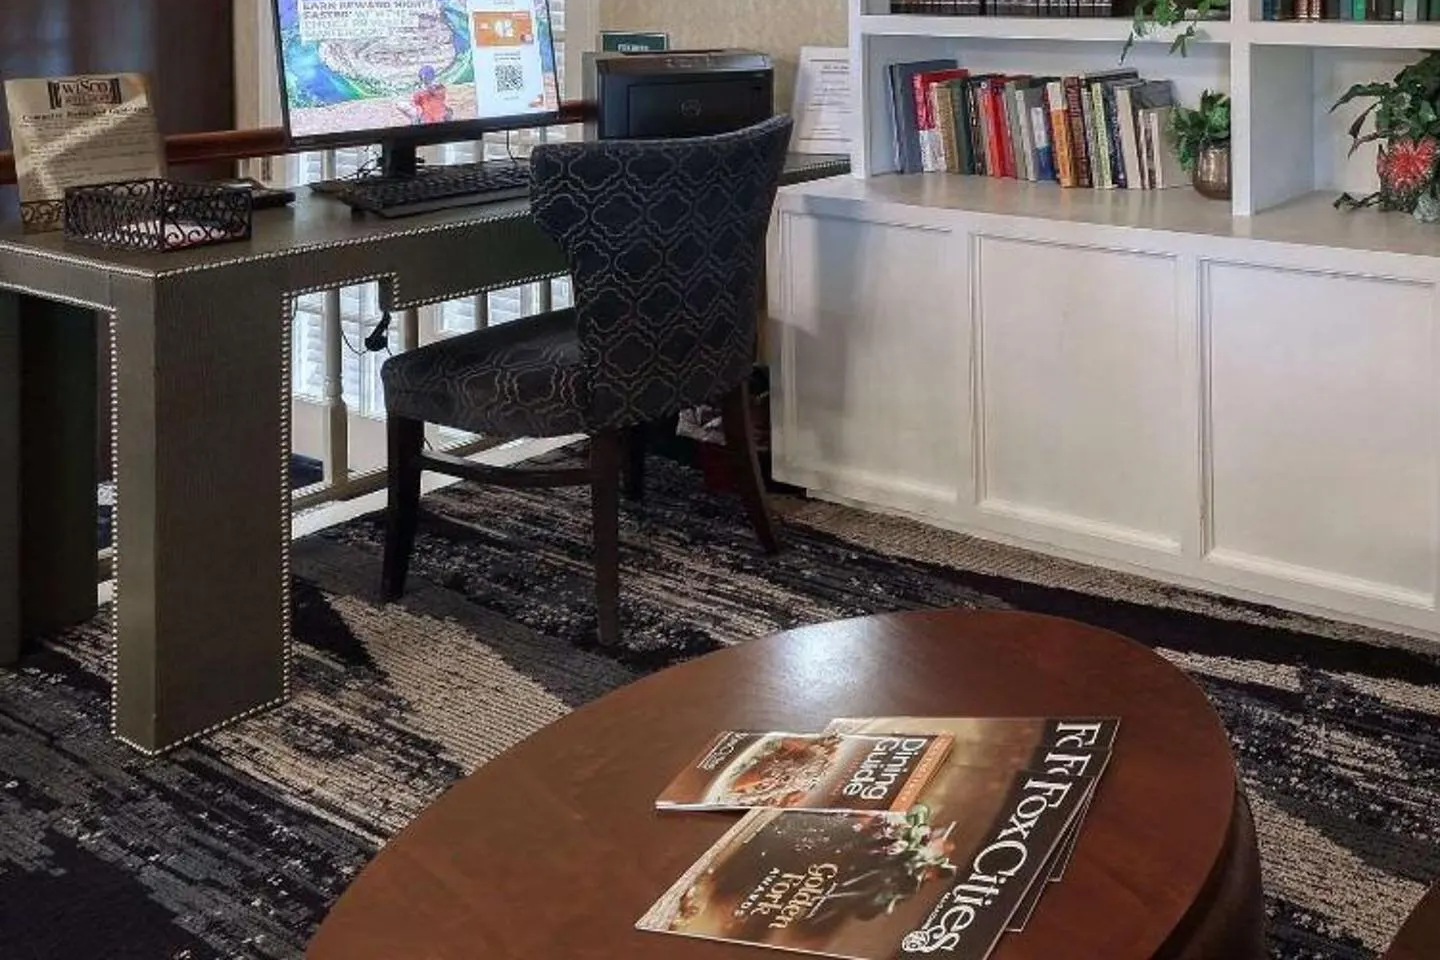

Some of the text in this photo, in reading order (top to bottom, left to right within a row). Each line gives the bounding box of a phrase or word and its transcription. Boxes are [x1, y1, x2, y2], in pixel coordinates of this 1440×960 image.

[843, 738, 899, 797] Guide
[861, 738, 927, 800] Dining
[750, 872, 807, 917] Fork
[768, 863, 838, 928] Golden
